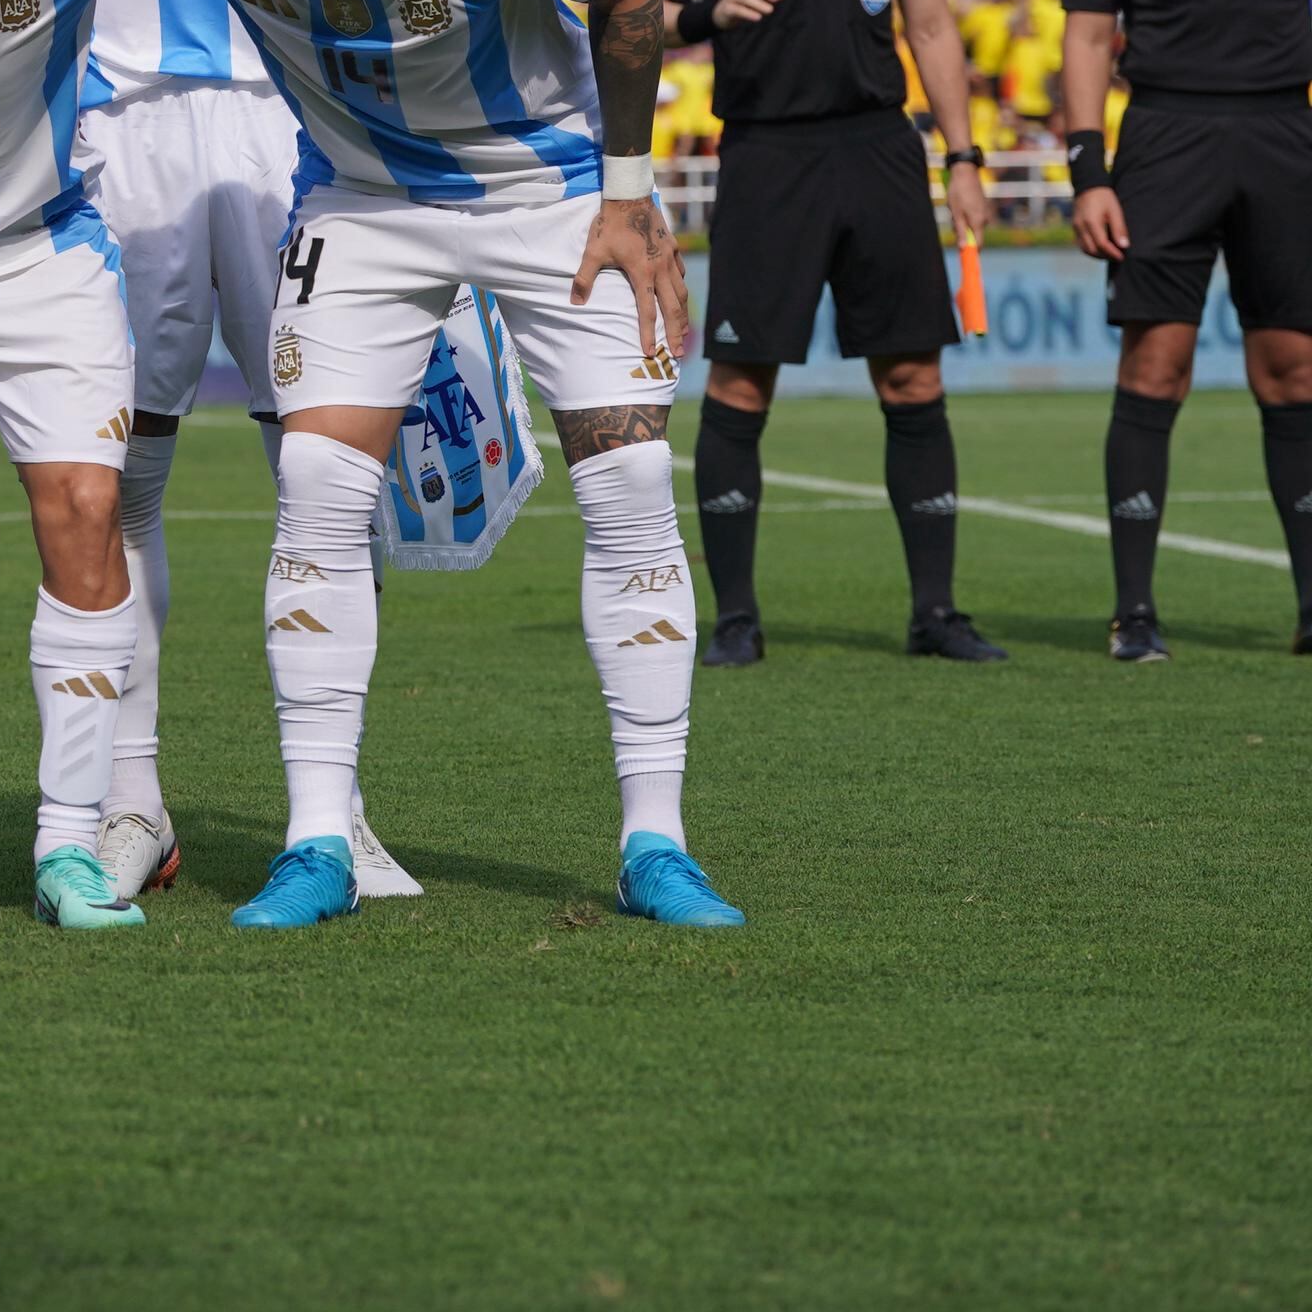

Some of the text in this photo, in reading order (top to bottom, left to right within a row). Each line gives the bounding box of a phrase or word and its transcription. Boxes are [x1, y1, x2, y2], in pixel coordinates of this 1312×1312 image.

[322, 48, 394, 104] 14
[978, 273, 1082, 354] ÓN
[278, 350, 295, 373] AFA
[421, 372, 486, 452] AFA
[271, 554, 329, 583] AFA
[620, 564, 683, 593] AFA
